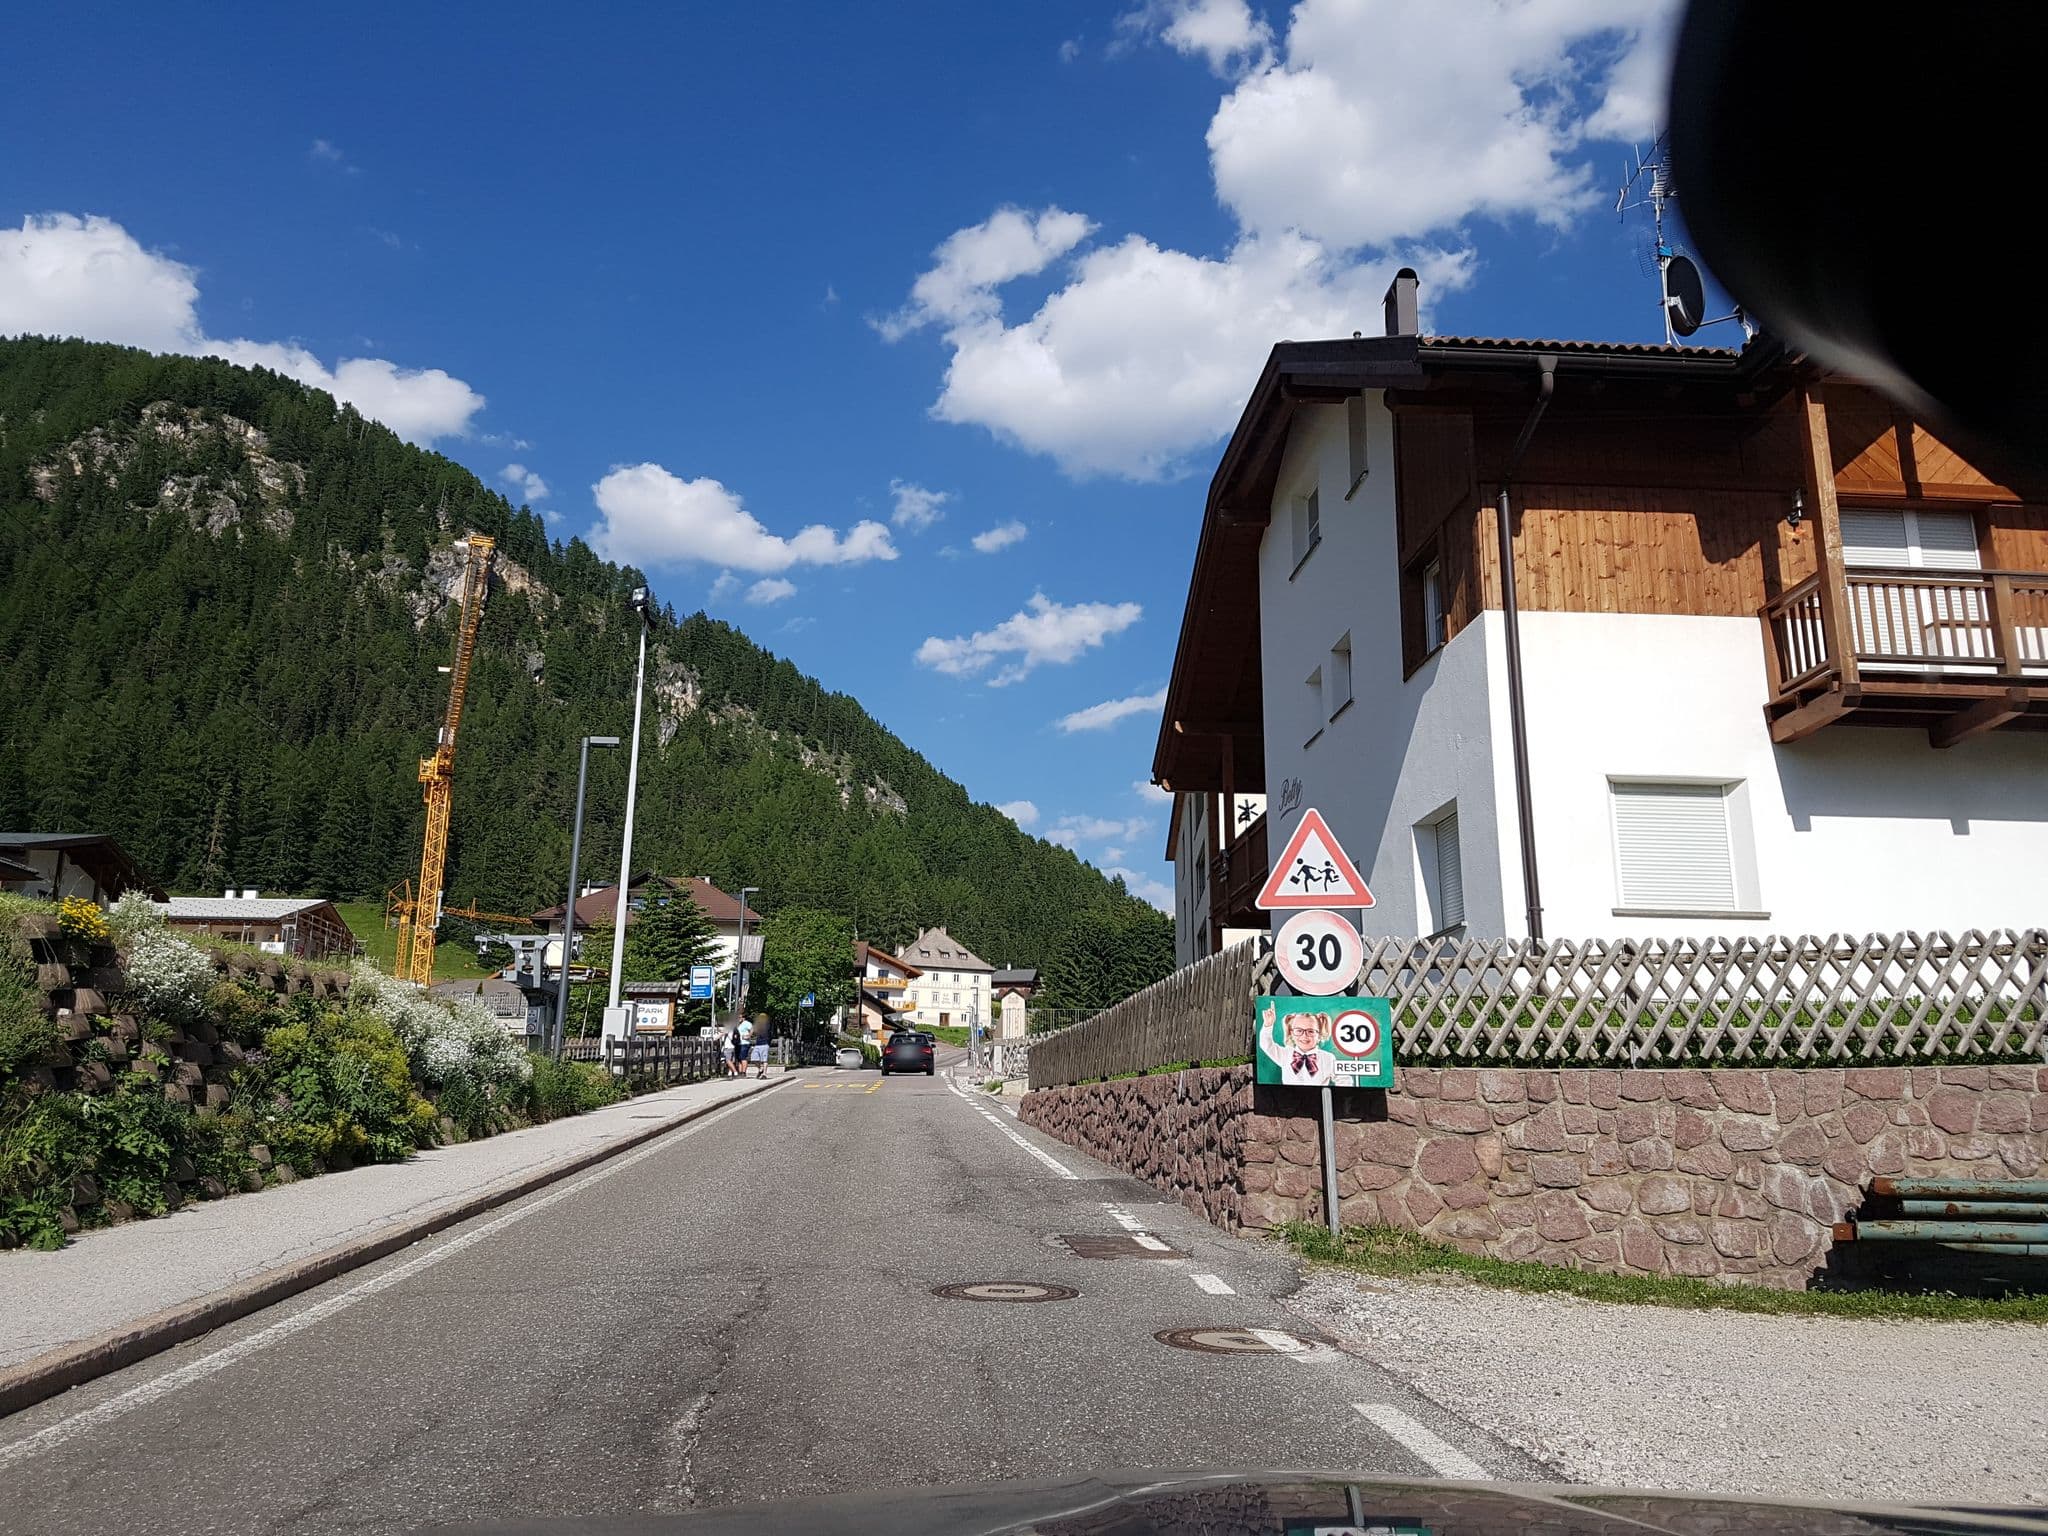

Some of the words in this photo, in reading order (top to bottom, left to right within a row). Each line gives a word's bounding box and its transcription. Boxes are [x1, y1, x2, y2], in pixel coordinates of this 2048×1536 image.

[1296, 934, 1342, 971] 30
[1340, 1025, 1371, 1043] 30
[1336, 1063, 1378, 1073] RESPET
